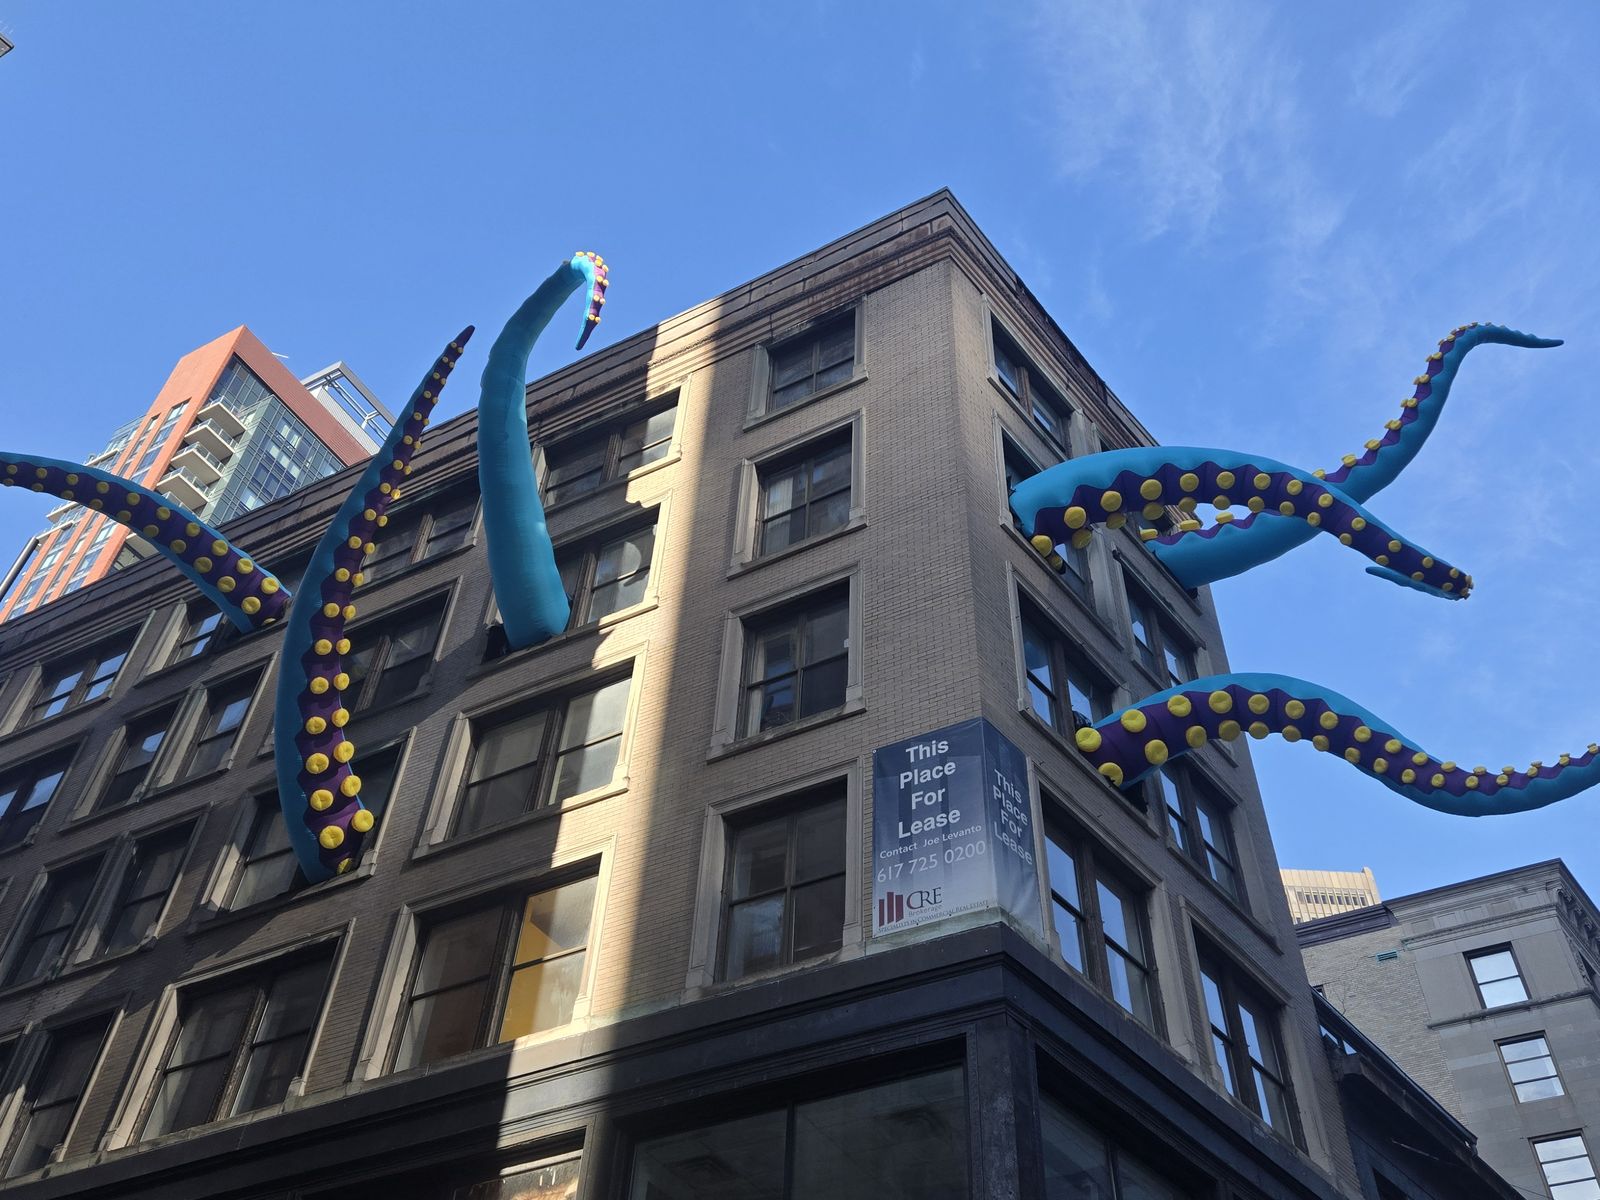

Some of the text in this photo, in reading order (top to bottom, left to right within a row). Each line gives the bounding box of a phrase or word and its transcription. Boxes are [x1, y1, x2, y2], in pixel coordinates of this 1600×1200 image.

[906, 739, 949, 763] This
[900, 761, 957, 789] Place
[994, 768, 1022, 804] This
[911, 787, 946, 810] For
[992, 785, 1028, 826] Place
[898, 808, 961, 839] Lease
[1000, 809, 1023, 838] For
[879, 825, 982, 859] Contact Joe Levanto
[994, 821, 1033, 865] Lease
[877, 840, 986, 883] 617 725 0200
[906, 886, 942, 910] CRE
[908, 904, 942, 917] Brokerage
